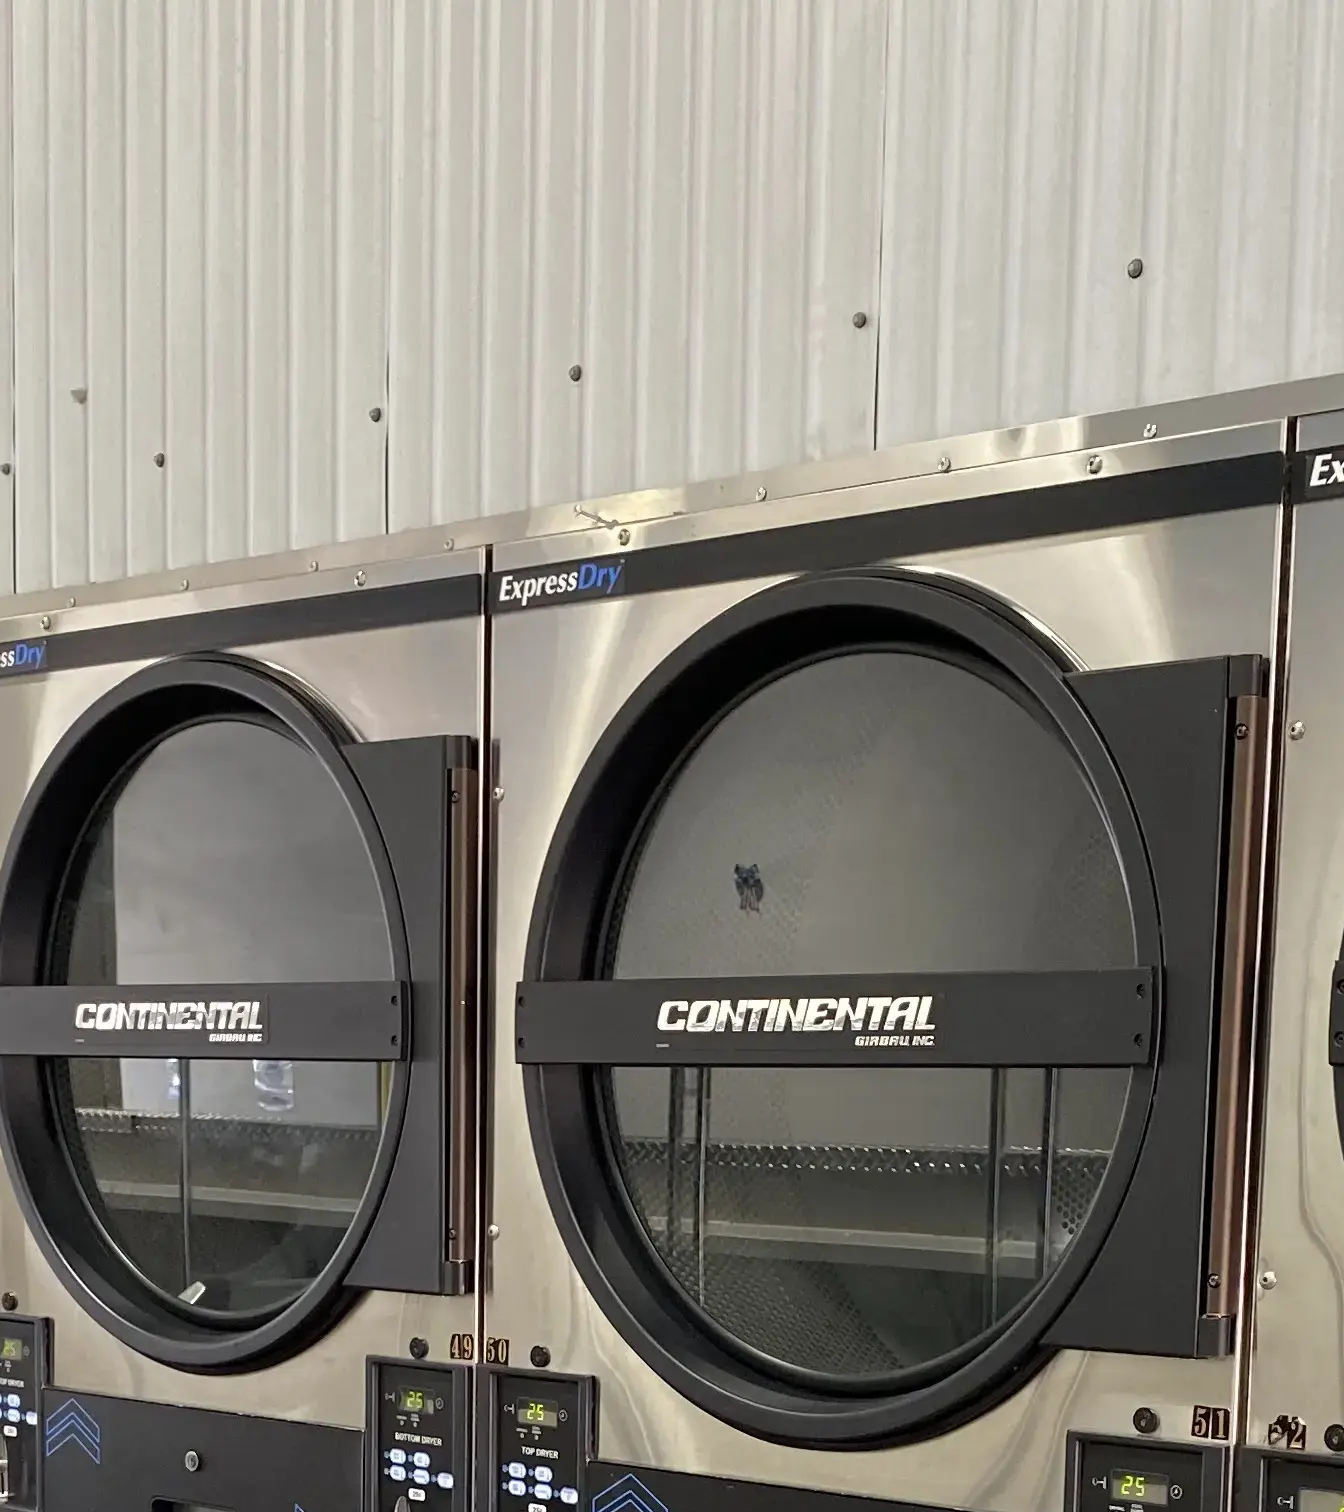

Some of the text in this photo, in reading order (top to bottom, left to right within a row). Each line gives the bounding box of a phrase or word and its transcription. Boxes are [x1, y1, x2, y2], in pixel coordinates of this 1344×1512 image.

[499, 562, 623, 605] ExpressDry
[75, 1002, 262, 1030] CONTINENTAL
[657, 996, 936, 1032] CONTINENTAL
[451, 1335, 473, 1359] 49
[487, 1338, 507, 1362] 50
[407, 1391, 424, 1409] 25
[527, 1403, 544, 1420] 25
[1194, 1407, 1228, 1438] 51
[1269, 1415, 1305, 1449] 52
[521, 1446, 558, 1459] TOP DRYER
[1121, 1475, 1145, 1497] 25
